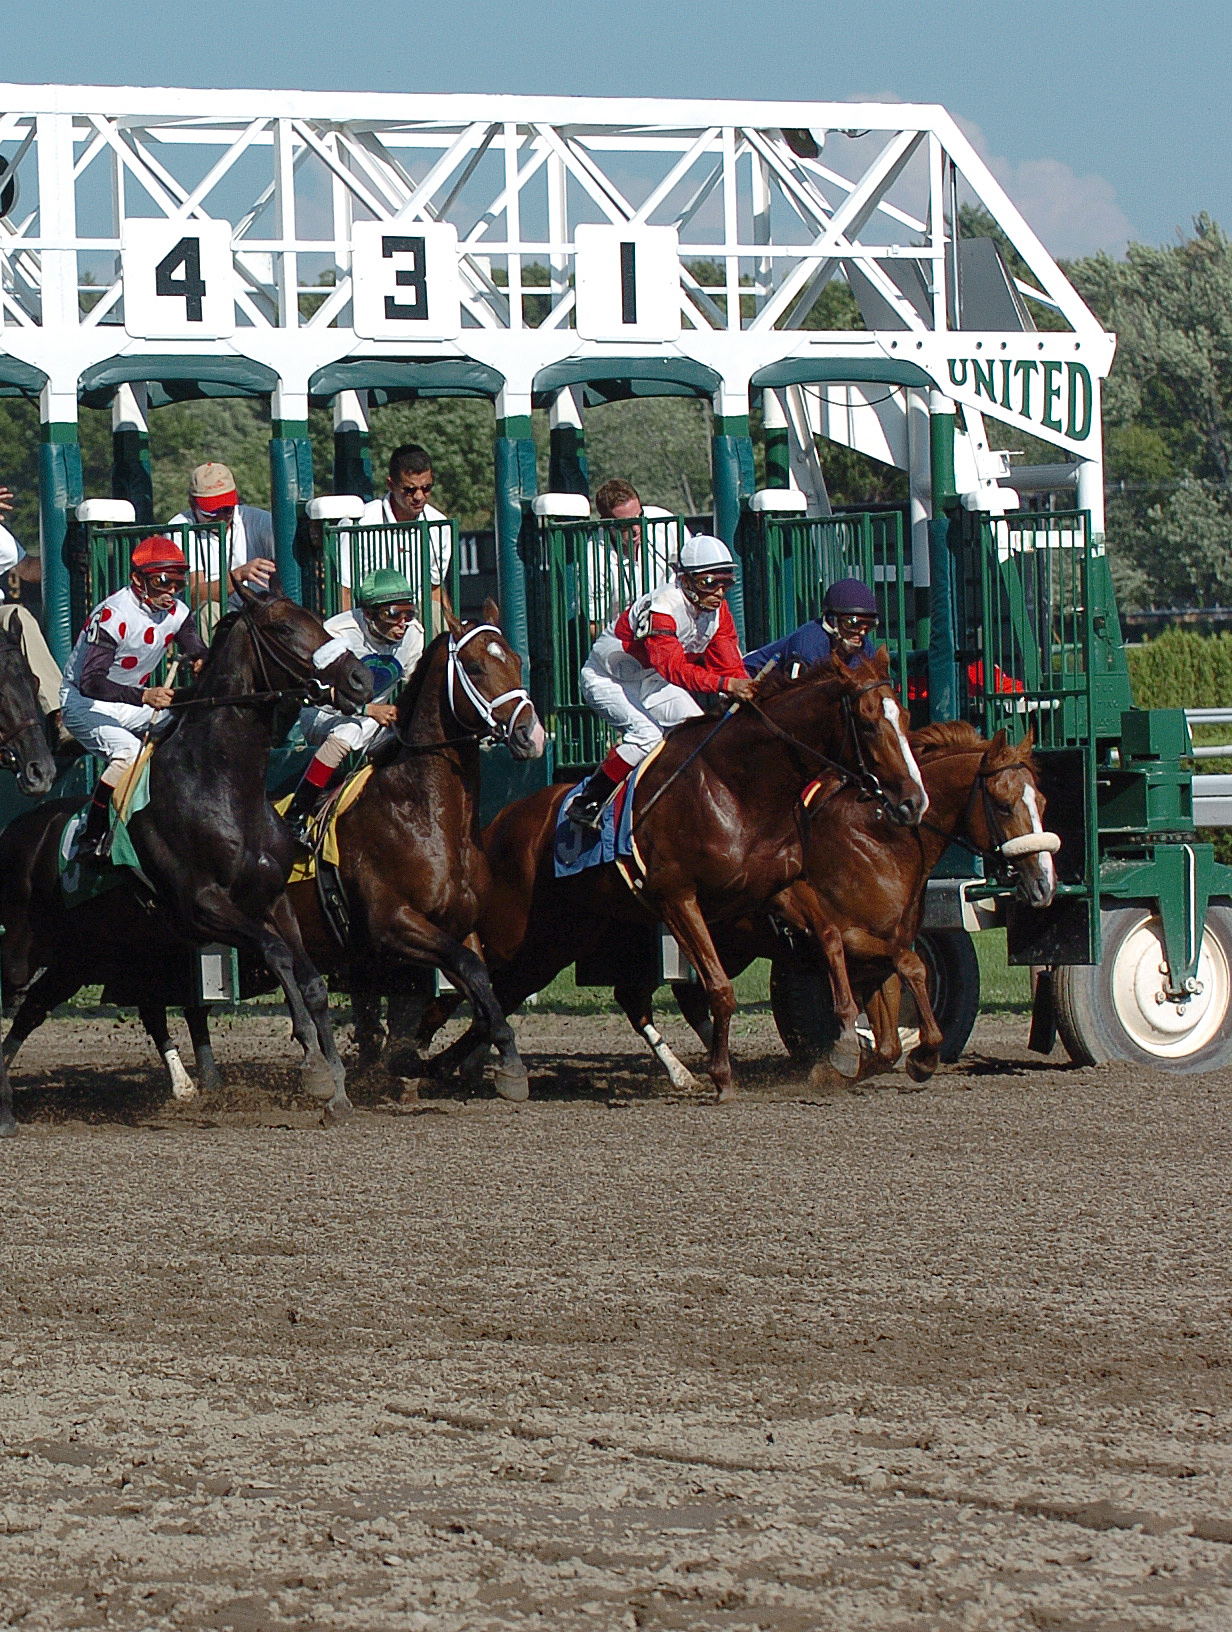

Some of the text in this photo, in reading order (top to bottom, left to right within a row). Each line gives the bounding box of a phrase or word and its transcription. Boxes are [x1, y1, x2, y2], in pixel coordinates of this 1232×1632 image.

[155, 237, 207, 322] 4
[382, 236, 428, 320] 3
[620, 241, 638, 324] 1
[946, 358, 1093, 442] UNITED
[87, 613, 102, 643] 5
[635, 609, 650, 639] 3
